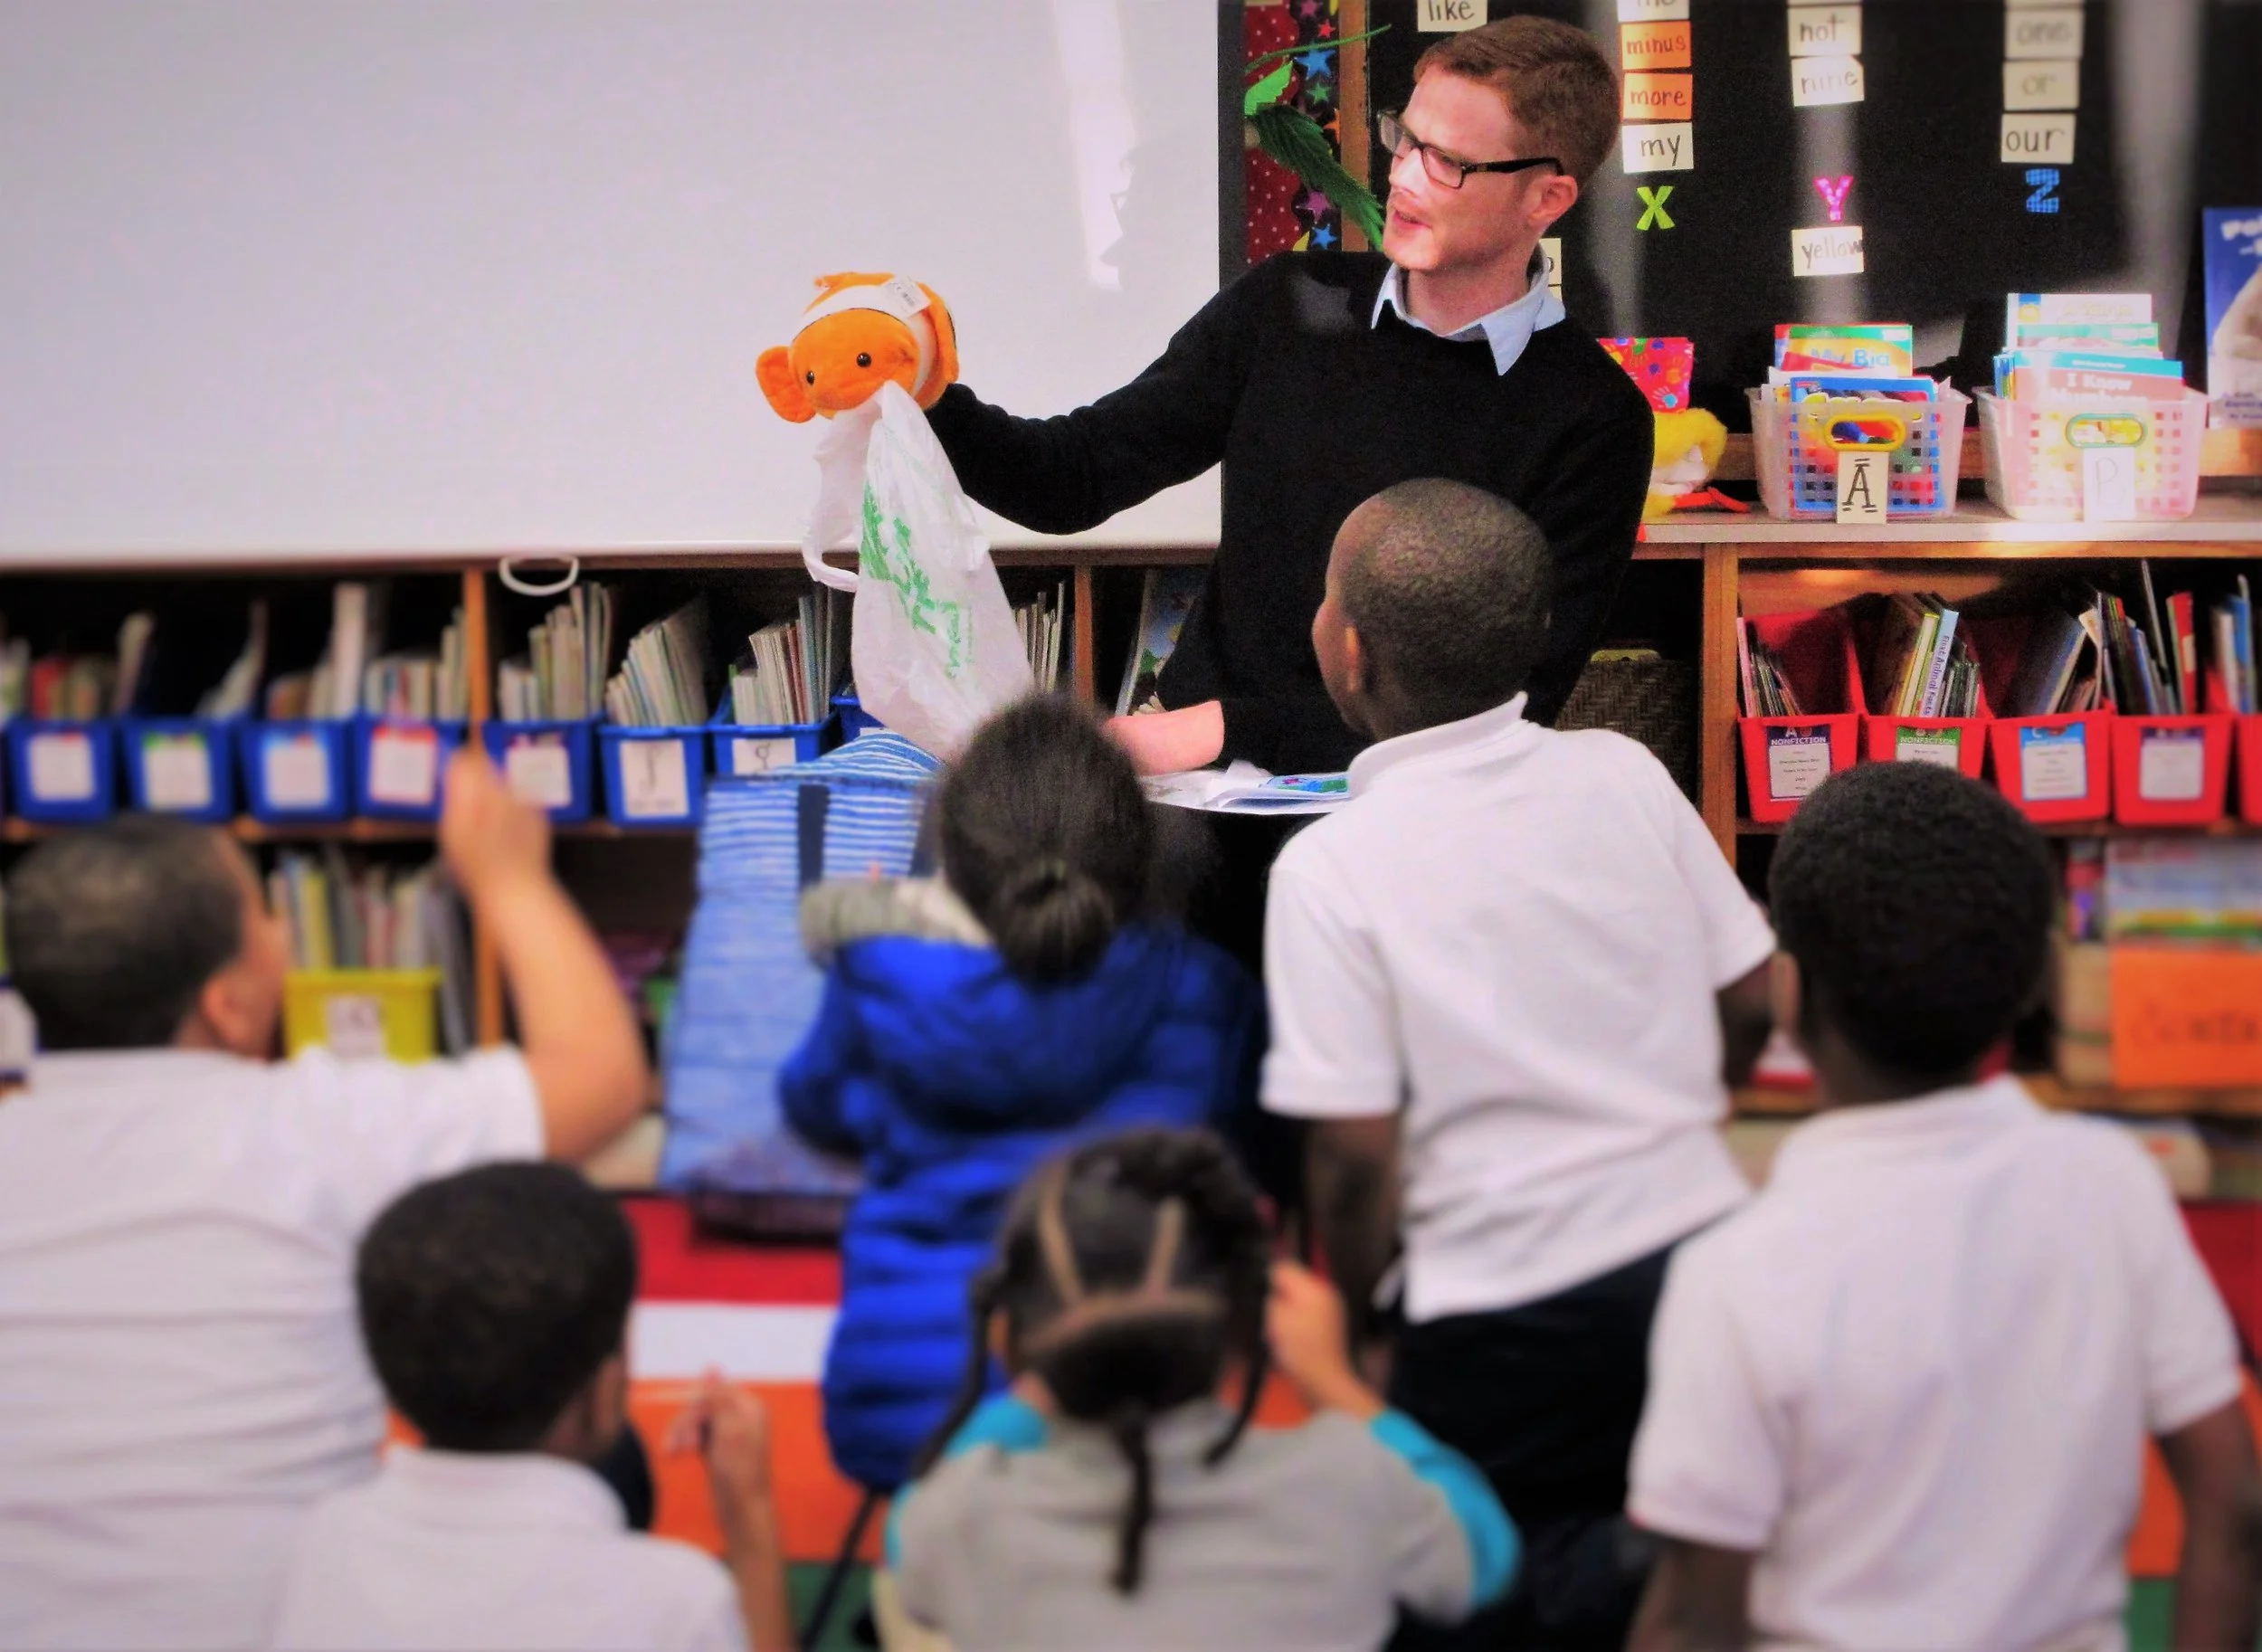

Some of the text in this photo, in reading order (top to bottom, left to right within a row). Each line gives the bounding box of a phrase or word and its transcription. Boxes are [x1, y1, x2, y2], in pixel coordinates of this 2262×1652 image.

[1429, 0, 1475, 22] like
[1799, 13, 1847, 43] not
[1626, 33, 1687, 54] minus
[1801, 71, 1858, 95] nine
[2022, 72, 2058, 96] or
[1630, 90, 1687, 107] more
[1640, 134, 1681, 166] my
[2005, 128, 2067, 152] our
[1812, 176, 1854, 223] Y
[2025, 168, 2059, 214] Z
[1636, 185, 1676, 231] X
[1801, 235, 1864, 270] yellow
[1811, 347, 1847, 364] My
[2084, 374, 2133, 391] Know
[1842, 458, 1877, 513] A
[1938, 635, 1950, 655] First
[1928, 657, 1945, 689] Animal
[1771, 736, 1827, 746] NONFICTION
[1900, 736, 1957, 746] NONFICTION
